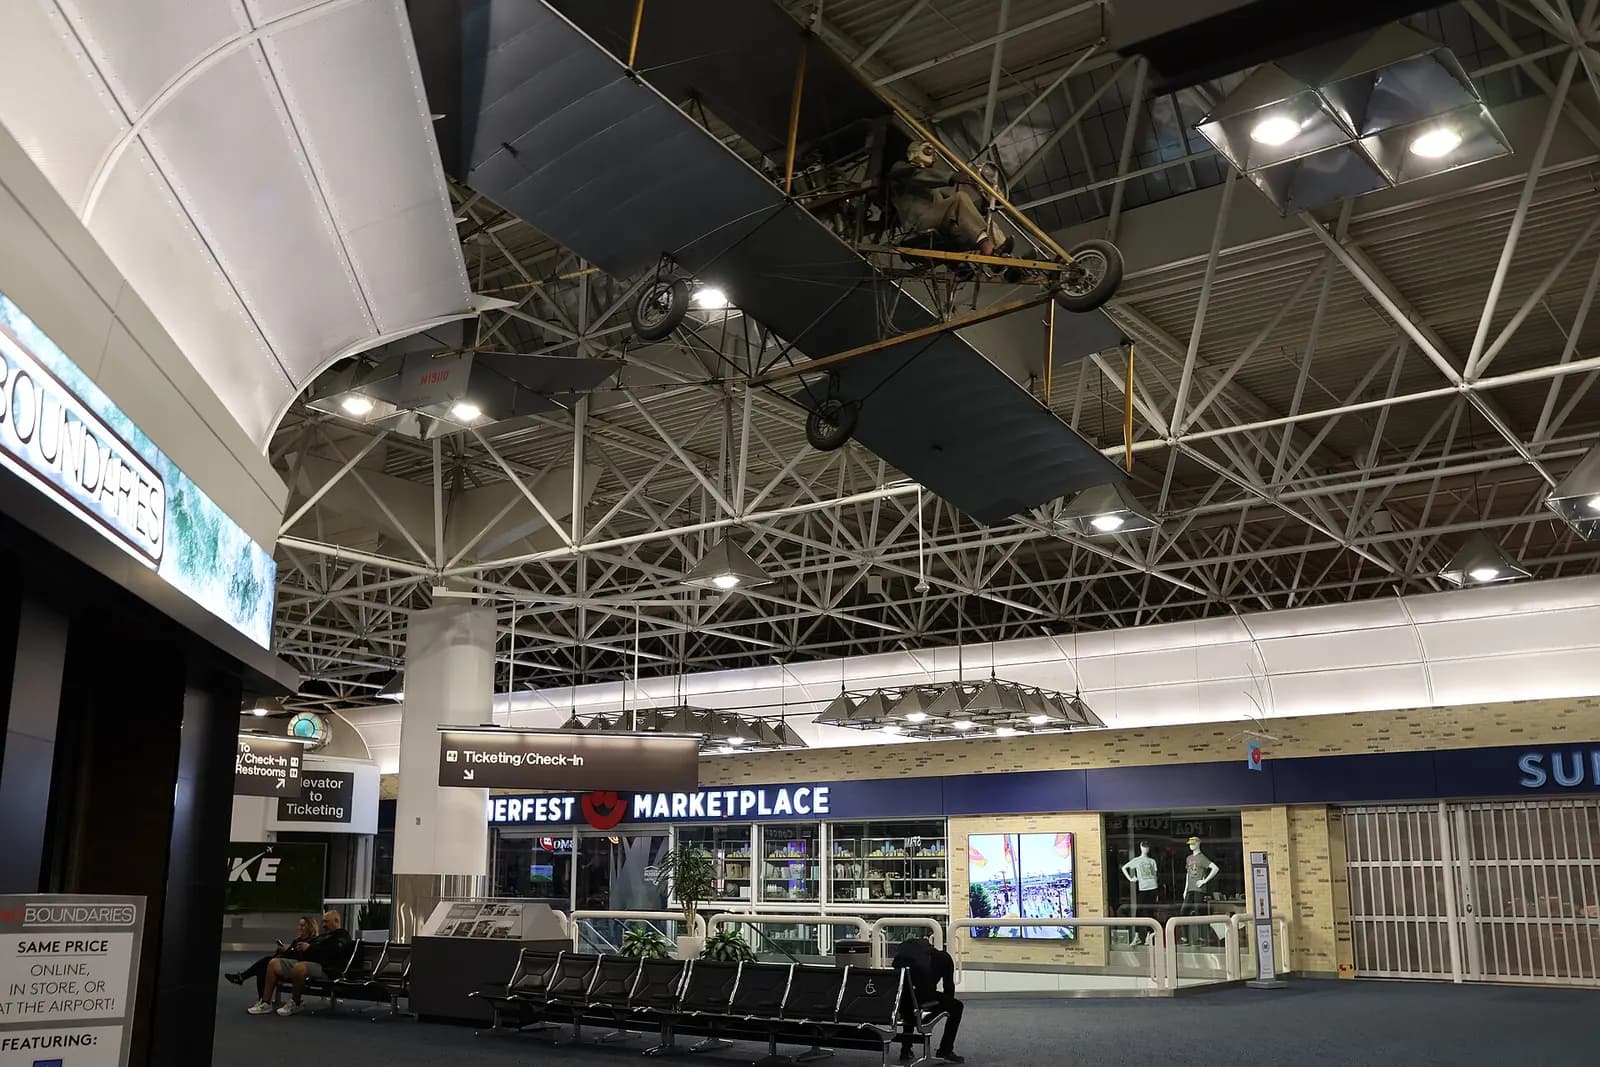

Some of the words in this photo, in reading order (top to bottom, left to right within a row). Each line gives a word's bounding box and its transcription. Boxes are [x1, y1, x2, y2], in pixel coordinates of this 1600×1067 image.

[239, 742, 251, 753] To
[464, 750, 584, 767] Ticketing/Check-In
[235, 764, 287, 778] Restrooms
[310, 790, 323, 802] to
[633, 786, 830, 819] MARKETPLACE
[286, 803, 344, 819] Ticketing
[228, 857, 282, 882] KE
[24, 907, 133, 923] BOUNDARIES
[17, 941, 61, 953] SAME
[64, 940, 109, 952] PRICE
[30, 963, 91, 977] ONLINE,
[9, 983, 26, 996] IN
[30, 982, 80, 996] STORE,
[84, 981, 106, 993] OR
[17, 1001, 45, 1014] THE
[49, 998, 115, 1013] AIRPORT!
[1, 1034, 98, 1051] FEATURING:
